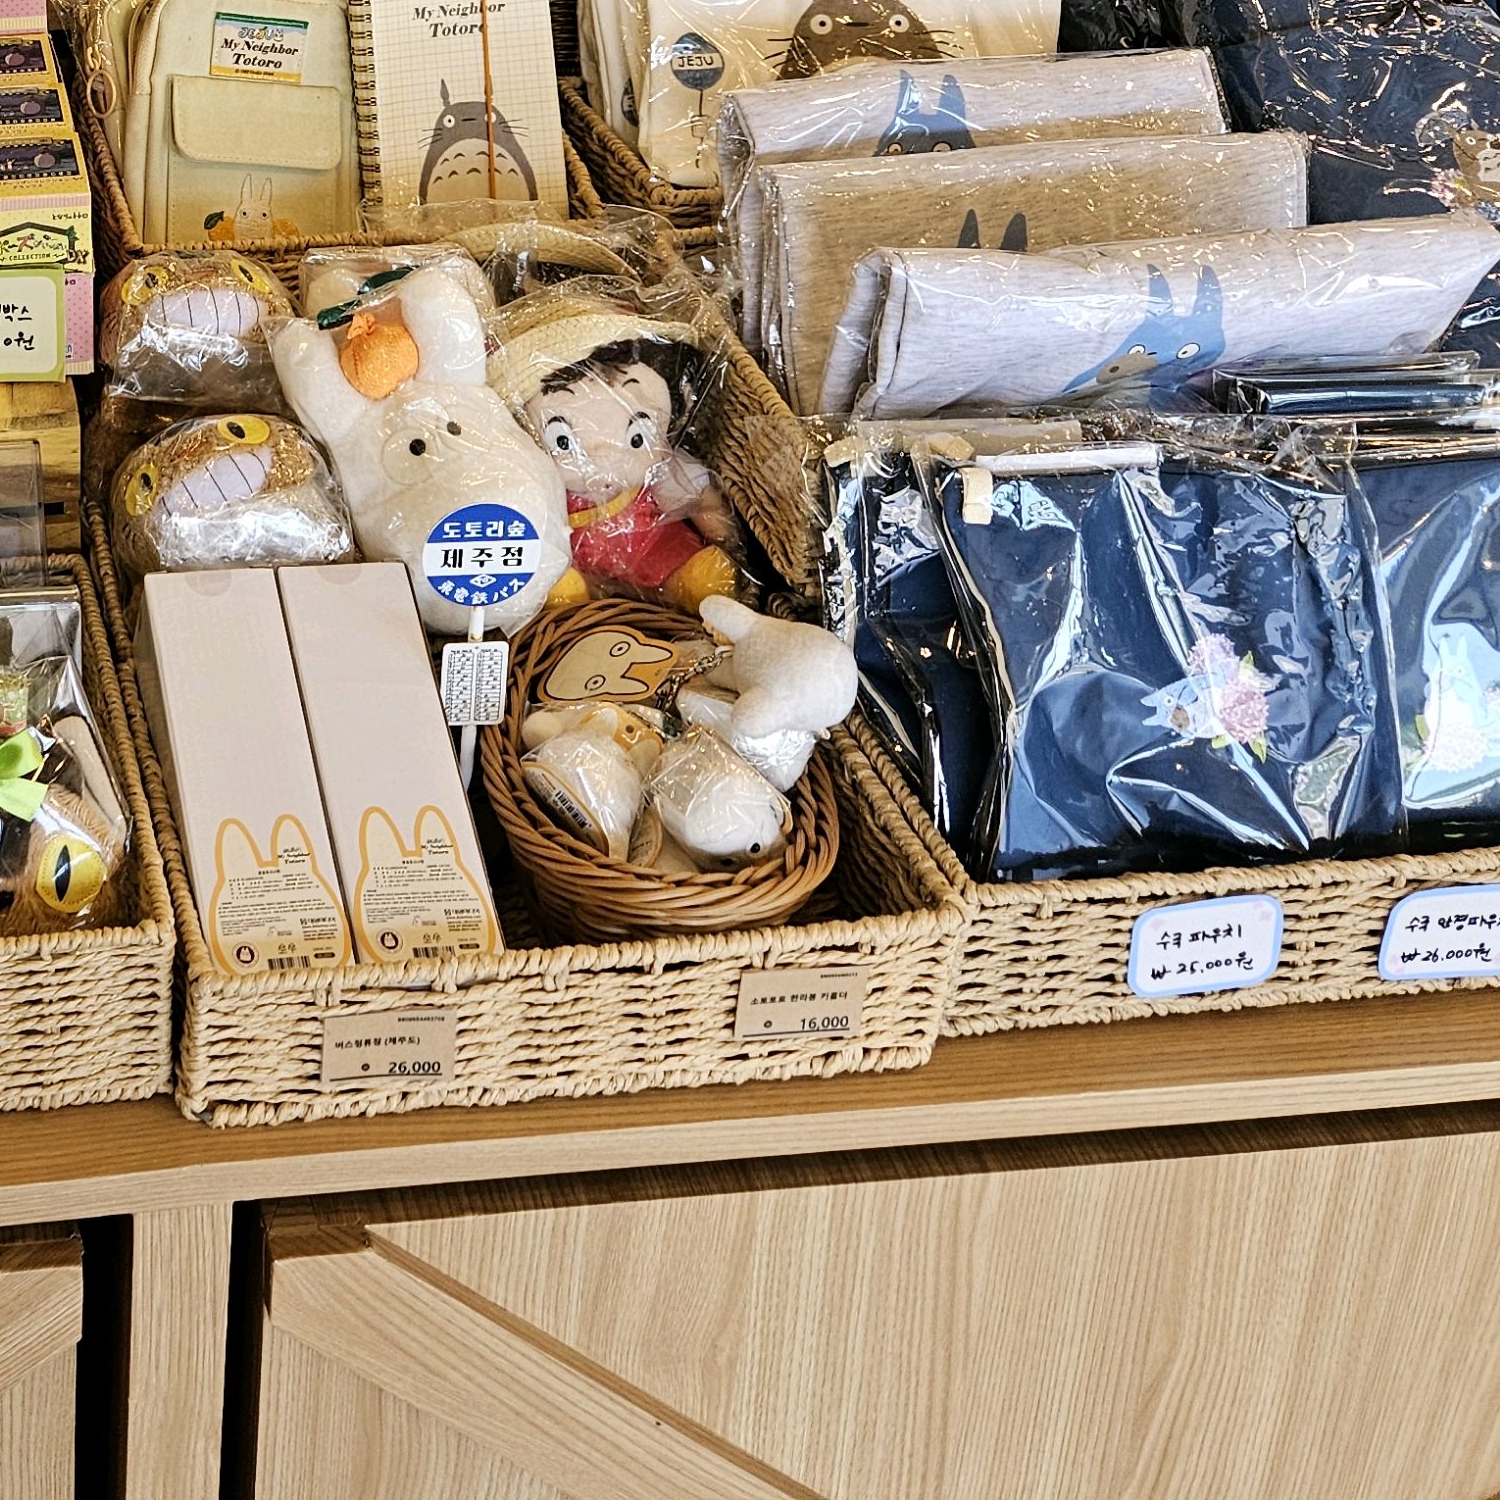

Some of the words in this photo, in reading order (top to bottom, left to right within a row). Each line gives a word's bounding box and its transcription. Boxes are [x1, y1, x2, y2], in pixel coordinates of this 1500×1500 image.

[412, 6, 435, 22] My
[220, 38, 240, 52] My
[241, 40, 299, 56] Neighbor
[232, 52, 283, 69] Totoro
[677, 55, 714, 68] JEJU
[8, 252, 51, 261] COLLECTION
[66, 248, 90, 264] DX
[442, 520, 526, 538] 도토리숲
[440, 546, 524, 568] 제주점
[1405, 915, 1430, 933] 수국
[1438, 913, 1500, 931] 안경파우
[1156, 931, 1182, 950] 수국
[1188, 923, 1242, 943] 파우치
[800, 1015, 849, 1031] 16,000
[335, 1037, 381, 1049] 버스정류장
[384, 1036, 420, 1046] (제주도)
[389, 1061, 441, 1076] 26,000
